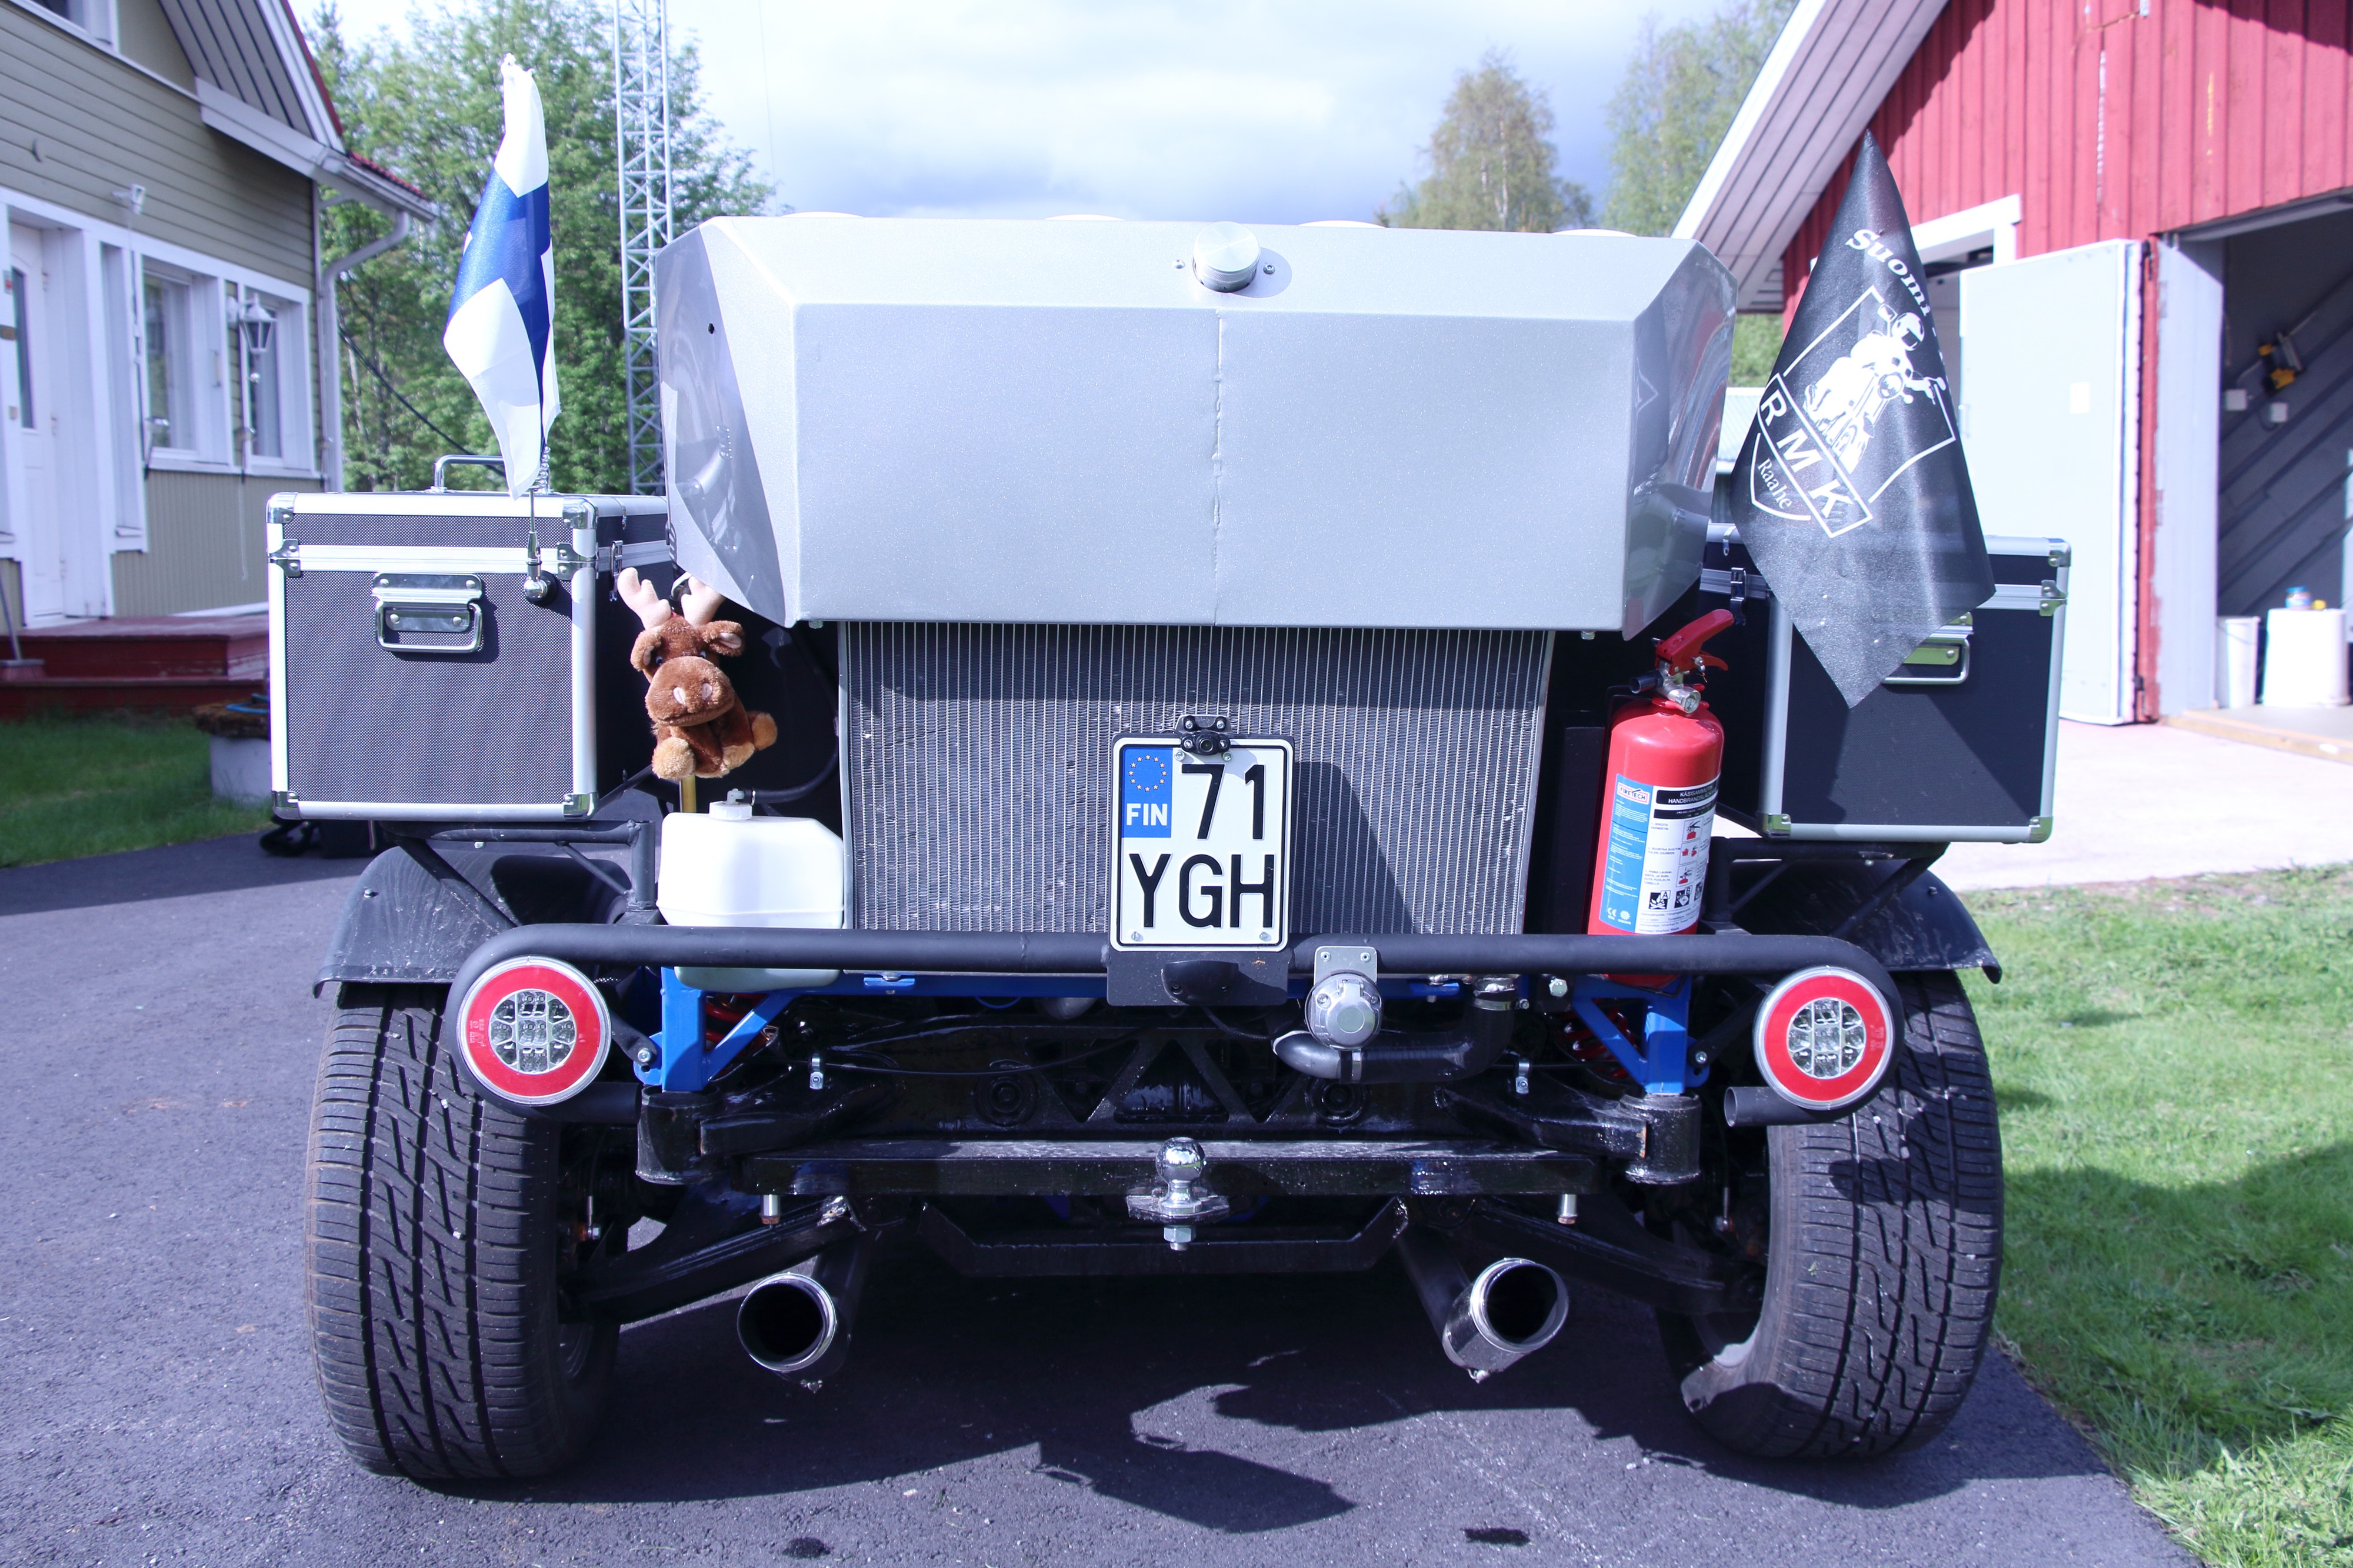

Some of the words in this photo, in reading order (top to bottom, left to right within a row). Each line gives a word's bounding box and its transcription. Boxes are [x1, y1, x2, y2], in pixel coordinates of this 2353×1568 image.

[1845, 229, 1931, 316] Suomi
[1757, 458, 1792, 509] Raahe
[1126, 802, 1168, 826] FIN
[1181, 763, 1266, 840] 71
[1620, 787, 1646, 800] FIRETECH
[1128, 853, 1275, 929] YGH
